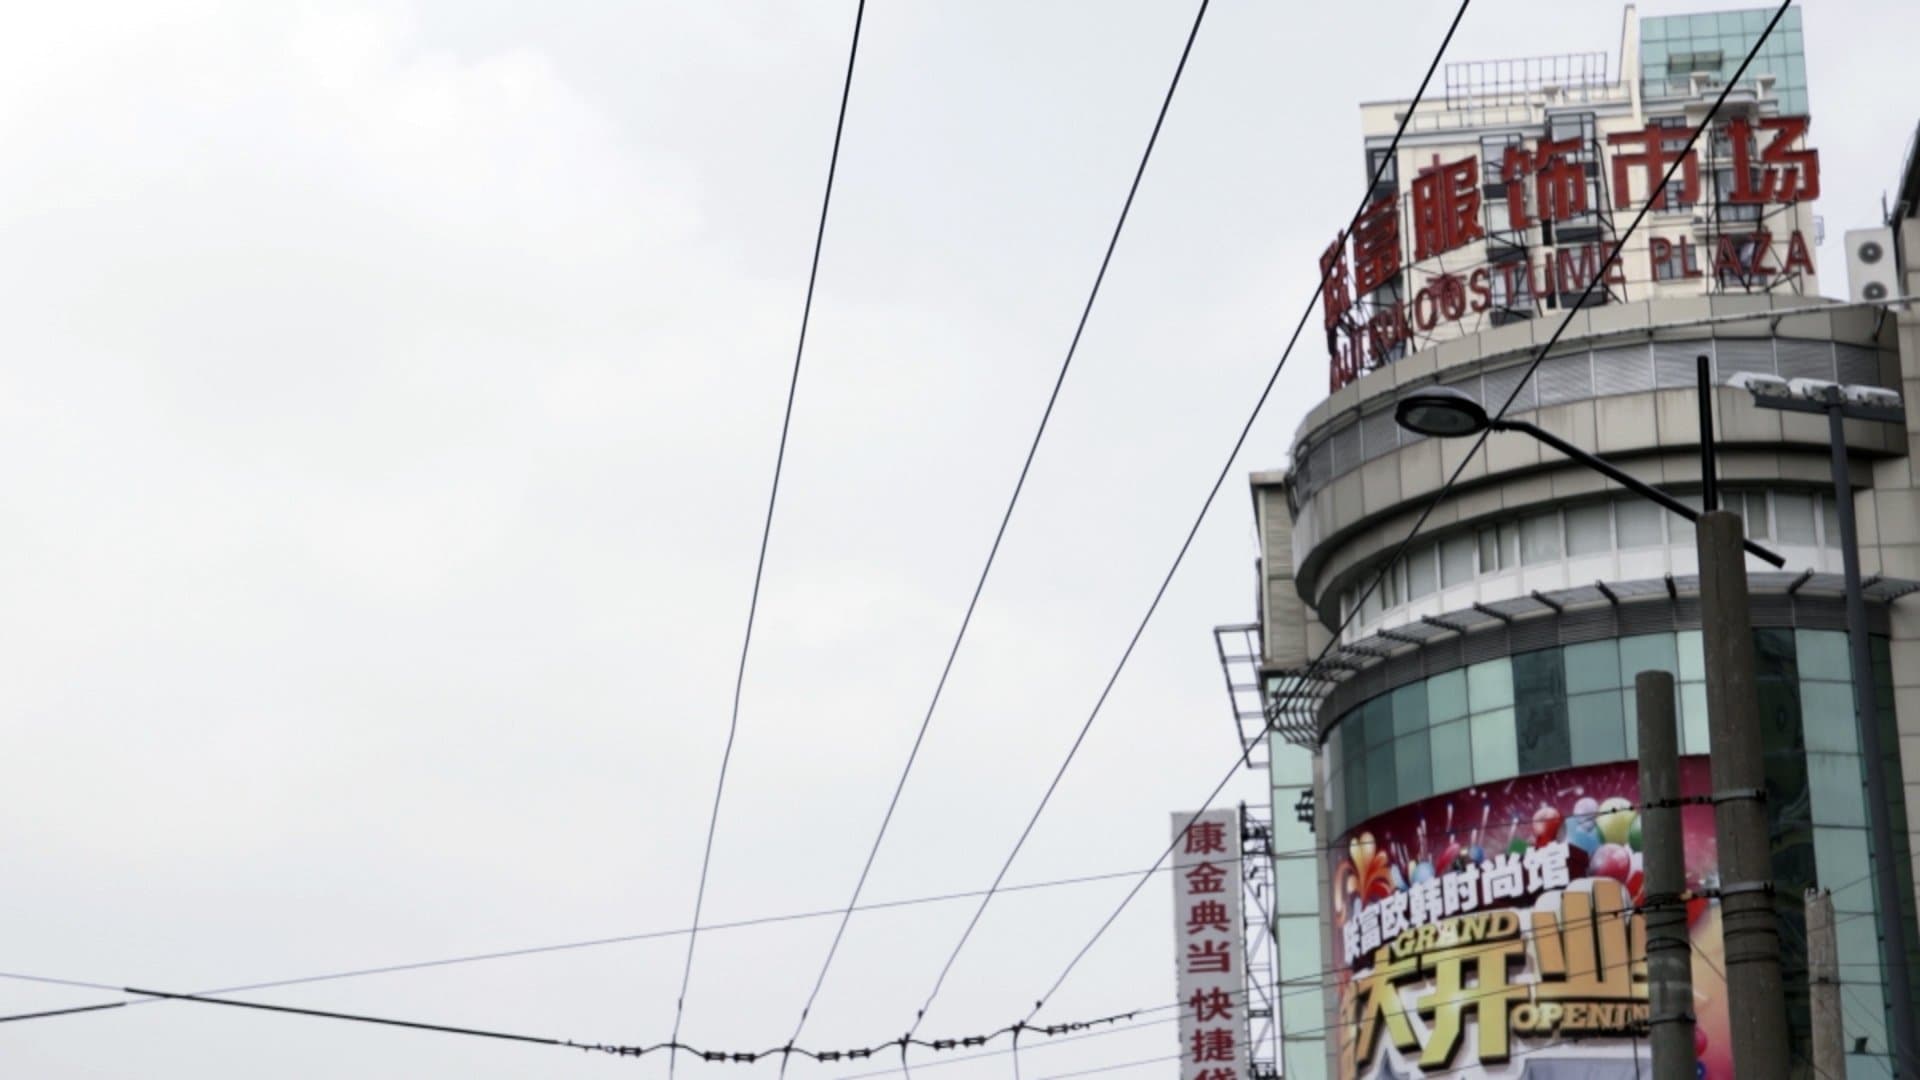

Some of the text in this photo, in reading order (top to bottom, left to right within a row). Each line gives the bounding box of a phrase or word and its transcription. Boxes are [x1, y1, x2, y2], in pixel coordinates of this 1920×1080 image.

[1415, 230, 1816, 331] COSTUME PLAZA
[1343, 841, 1570, 965] 联富欧韩时尚馆
[1393, 910, 1521, 957] GRAND
[1512, 1003, 1649, 1035] OPENIN
